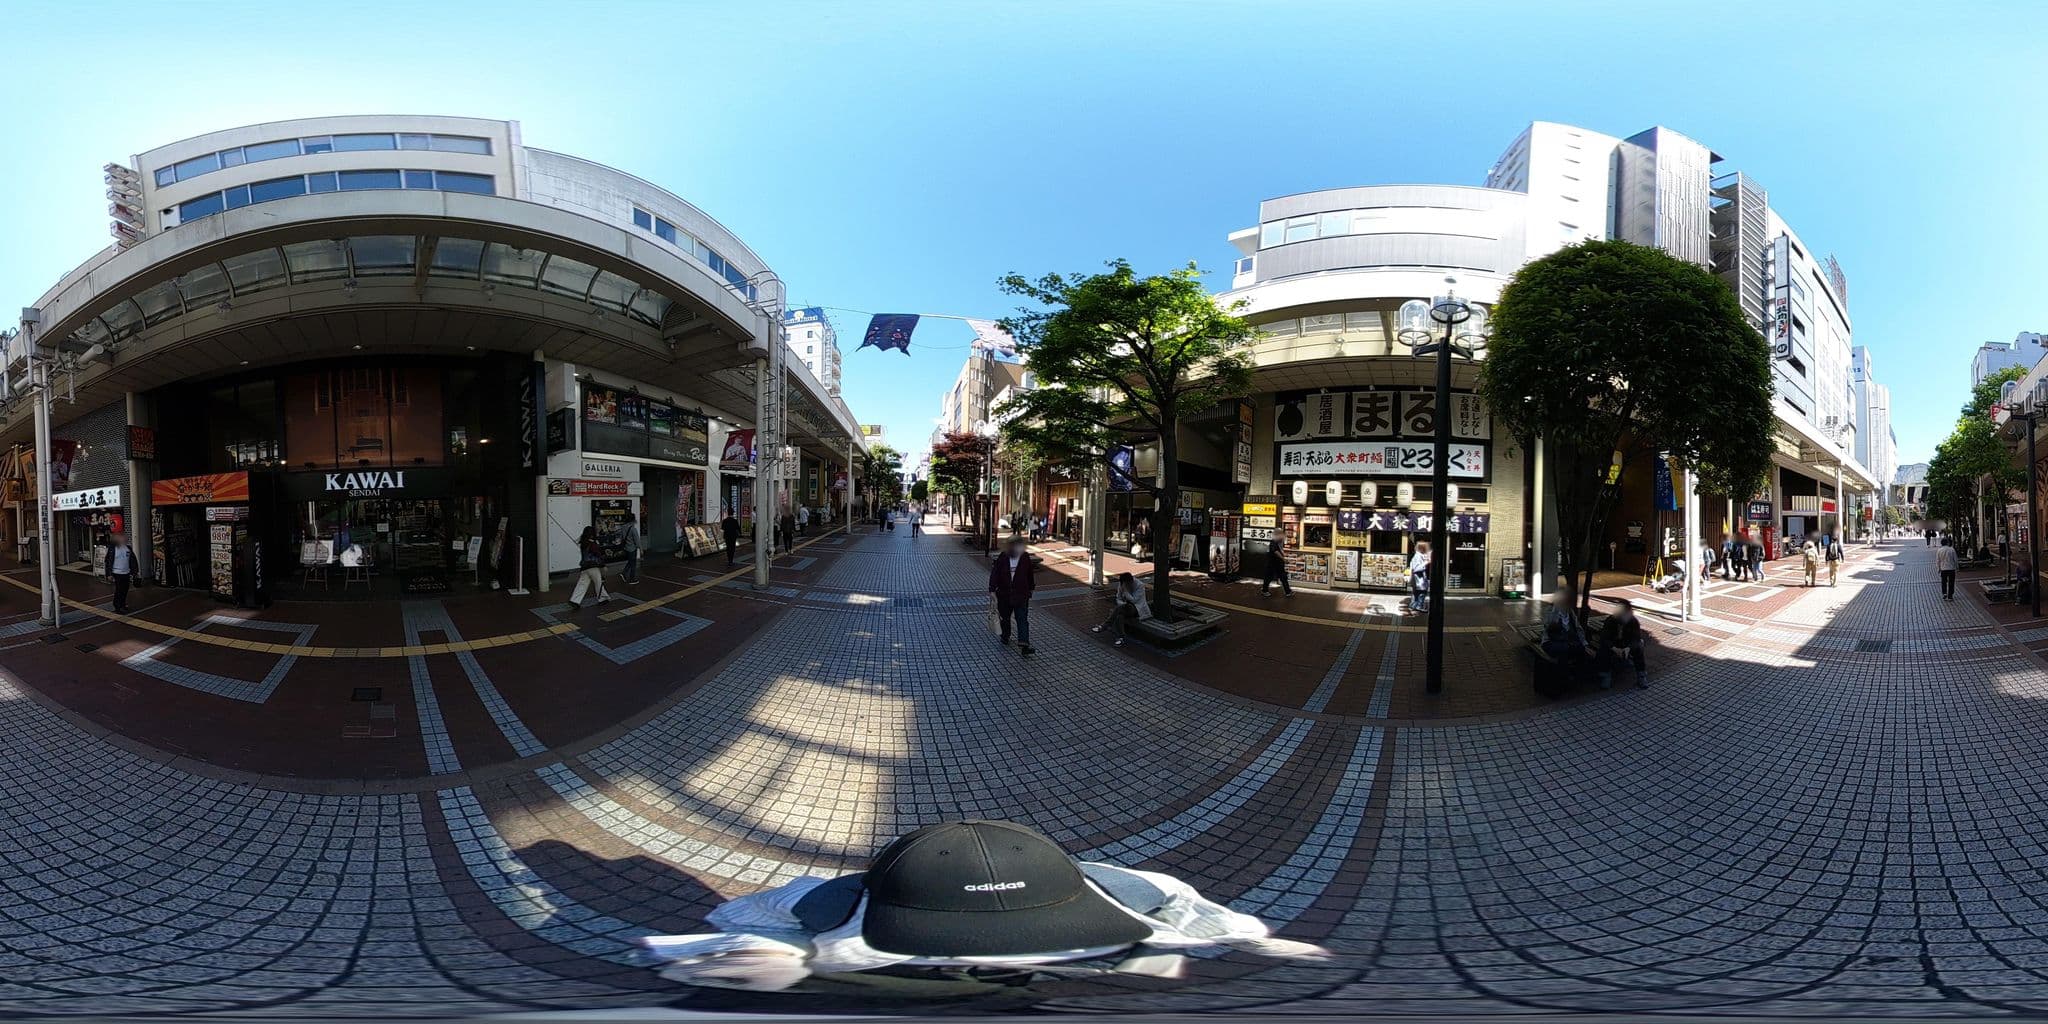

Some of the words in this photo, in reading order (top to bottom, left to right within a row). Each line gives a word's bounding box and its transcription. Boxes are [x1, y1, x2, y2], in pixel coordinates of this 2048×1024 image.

[1319, 395, 1333, 434] 居酒屋
[1283, 451, 1333, 466] 寿司・天ぷら
[1334, 452, 1382, 464] 大衆町鮨
[1401, 448, 1464, 470] とろく
[584, 464, 621, 473] GALLERIA
[325, 471, 404, 490] KAWAI
[349, 489, 381, 497] SENDAI
[963, 881, 1026, 891] adidas
